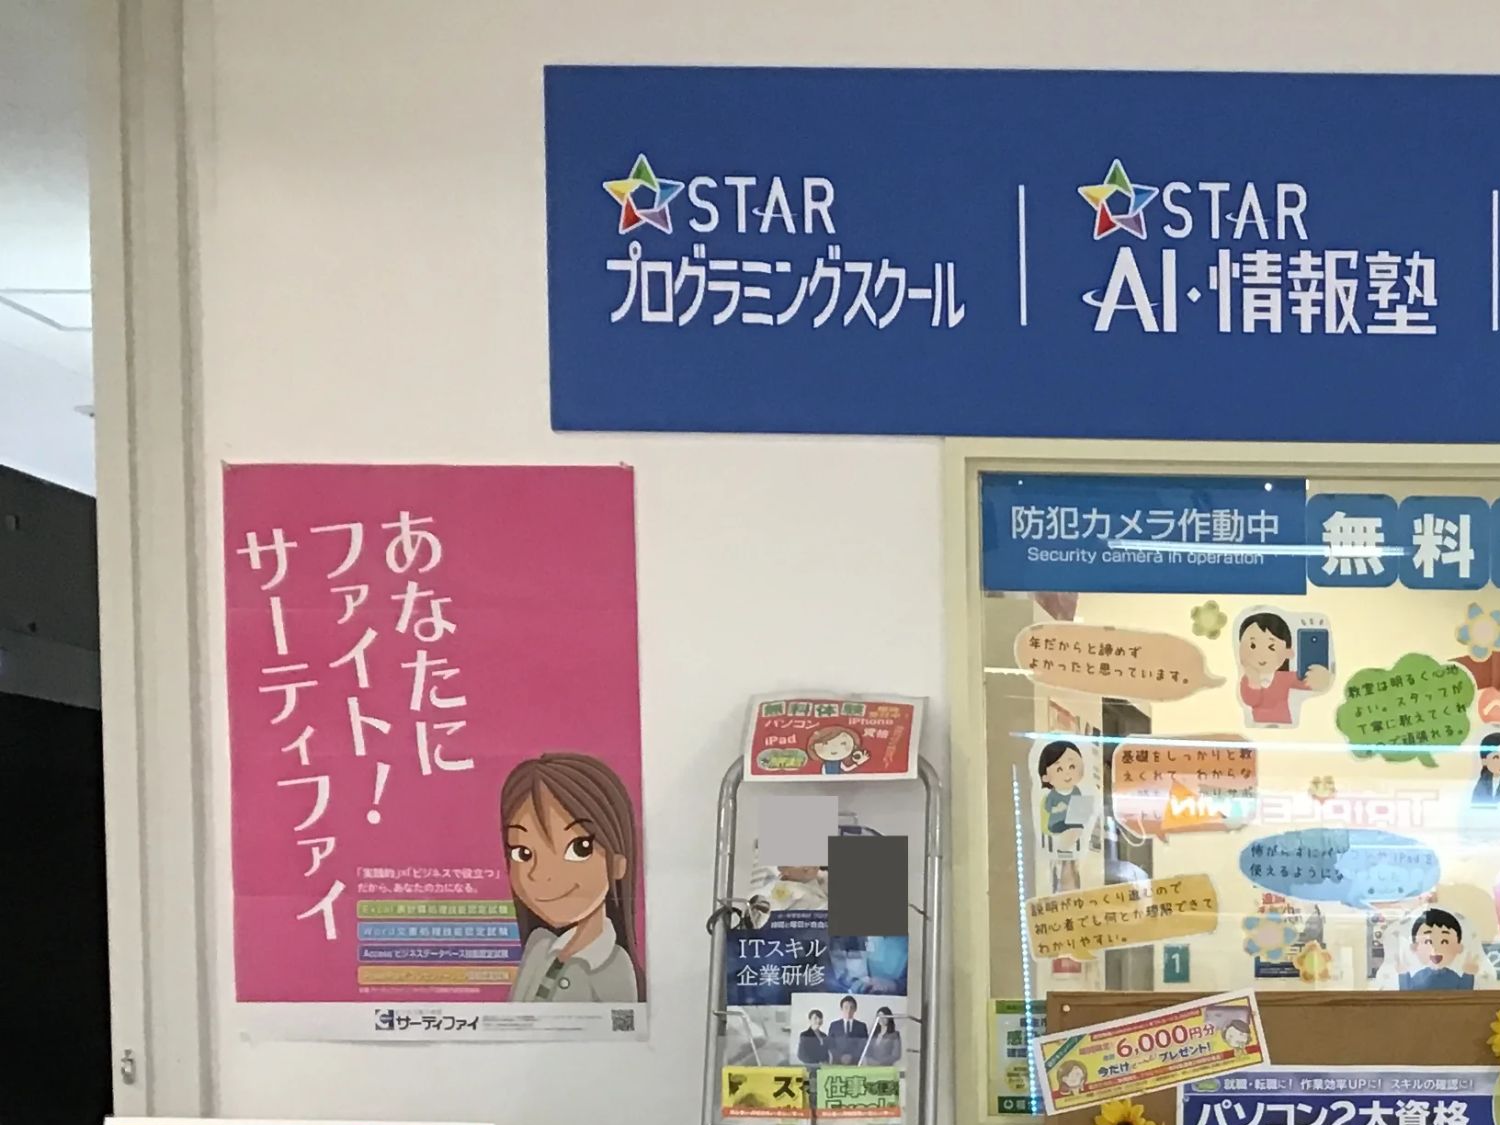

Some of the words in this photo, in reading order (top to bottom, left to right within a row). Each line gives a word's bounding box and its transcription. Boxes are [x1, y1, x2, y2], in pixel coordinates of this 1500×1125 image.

[689, 175, 836, 235] STAR
[1162, 181, 1308, 240] STAR
[607, 240, 965, 328] プログラミングスクール
[1082, 246, 1437, 335] AI・情報塾
[1010, 505, 1279, 543] 防犯カメラ作動中
[1027, 546, 1097, 564] Security
[381, 511, 474, 775] あなたに
[1029, 636, 1142, 658] 年だからと諦めず
[1029, 657, 1190, 685] よかったと思っています。
[1347, 663, 1459, 699] 教室は明るく心地
[237, 529, 346, 940] サーティファイ
[764, 720, 820, 729] パソコン
[1357, 701, 1468, 736] 丁寧に教えてくれ
[765, 734, 797, 746] iPad
[738, 939, 828, 959] ITスキル
[736, 964, 825, 987] 企業研修
[396, 1016, 479, 1030] サーティファイ
[1116, 1023, 1216, 1059] 6,000円分
[1097, 1062, 1130, 1078] 今だけ
[1158, 1042, 1212, 1064] プレゼント!
